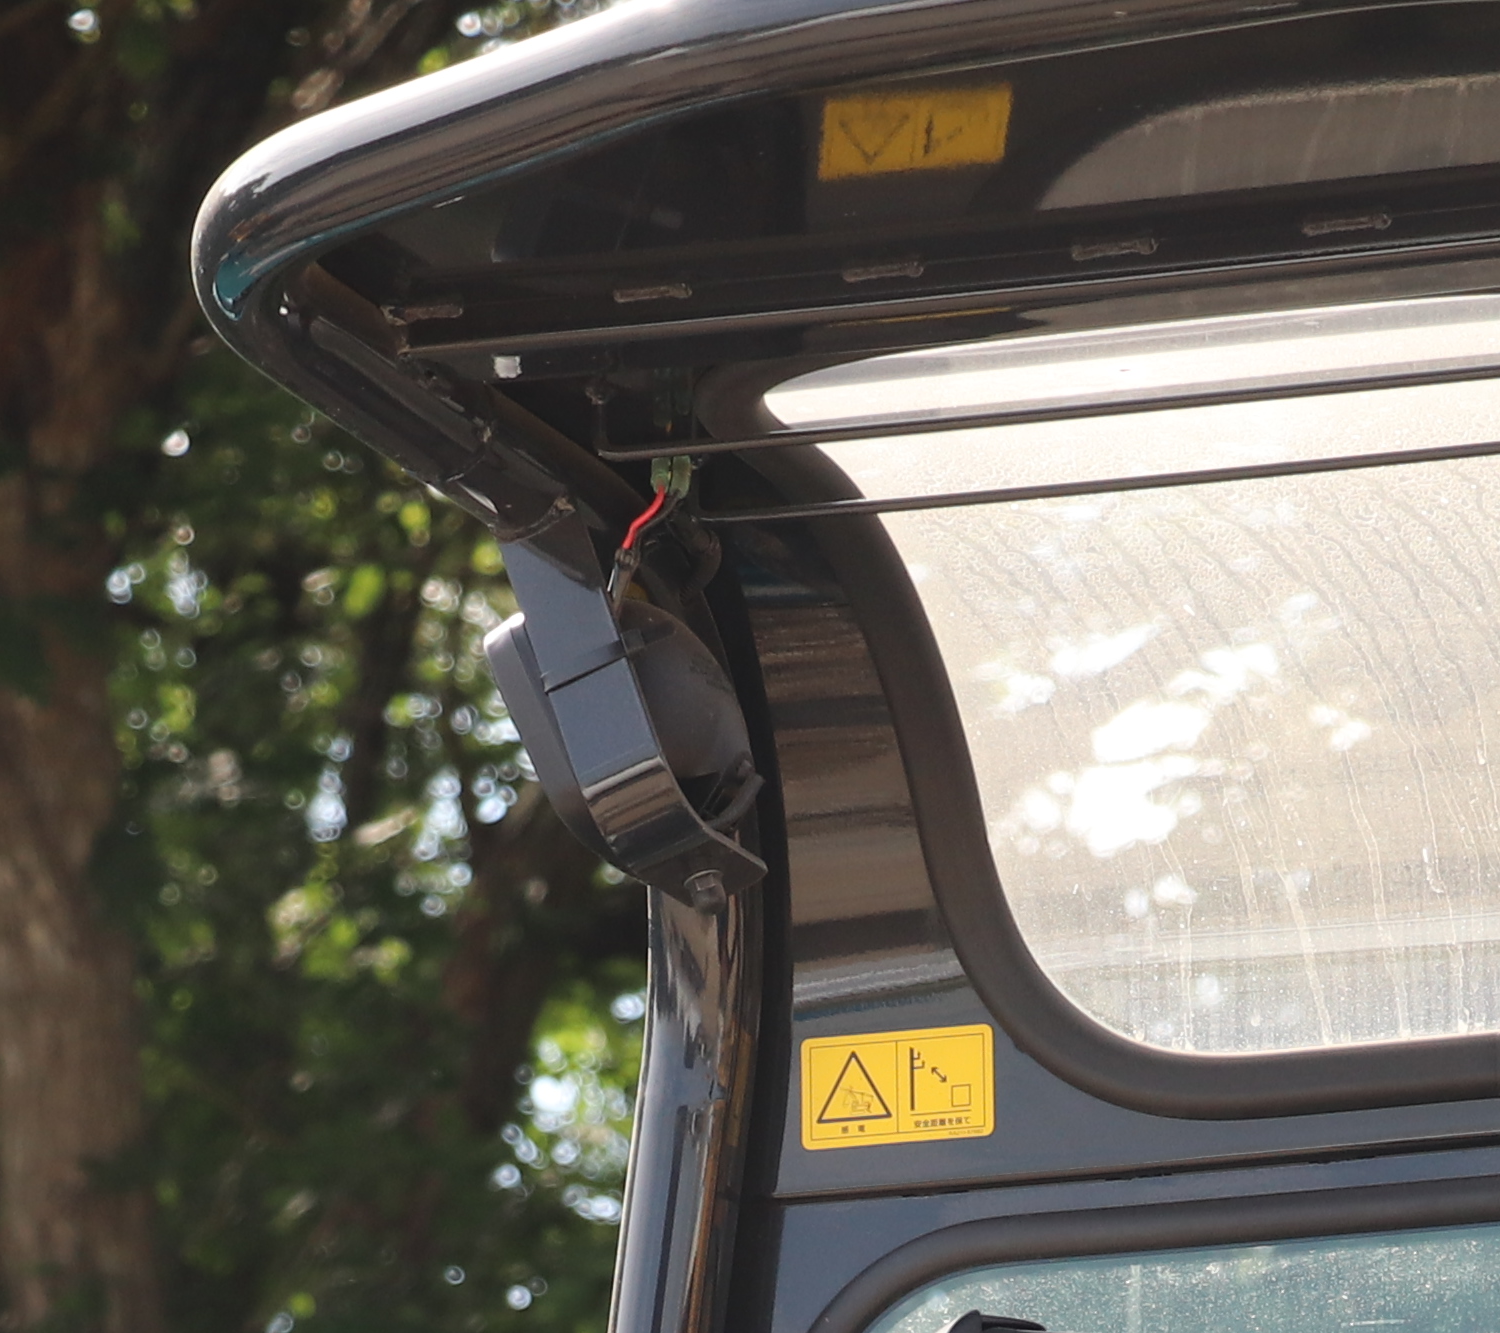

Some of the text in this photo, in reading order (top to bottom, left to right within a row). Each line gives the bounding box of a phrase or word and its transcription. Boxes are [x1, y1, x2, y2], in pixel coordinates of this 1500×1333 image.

[914, 1116, 972, 1130] 安全距離を保て
